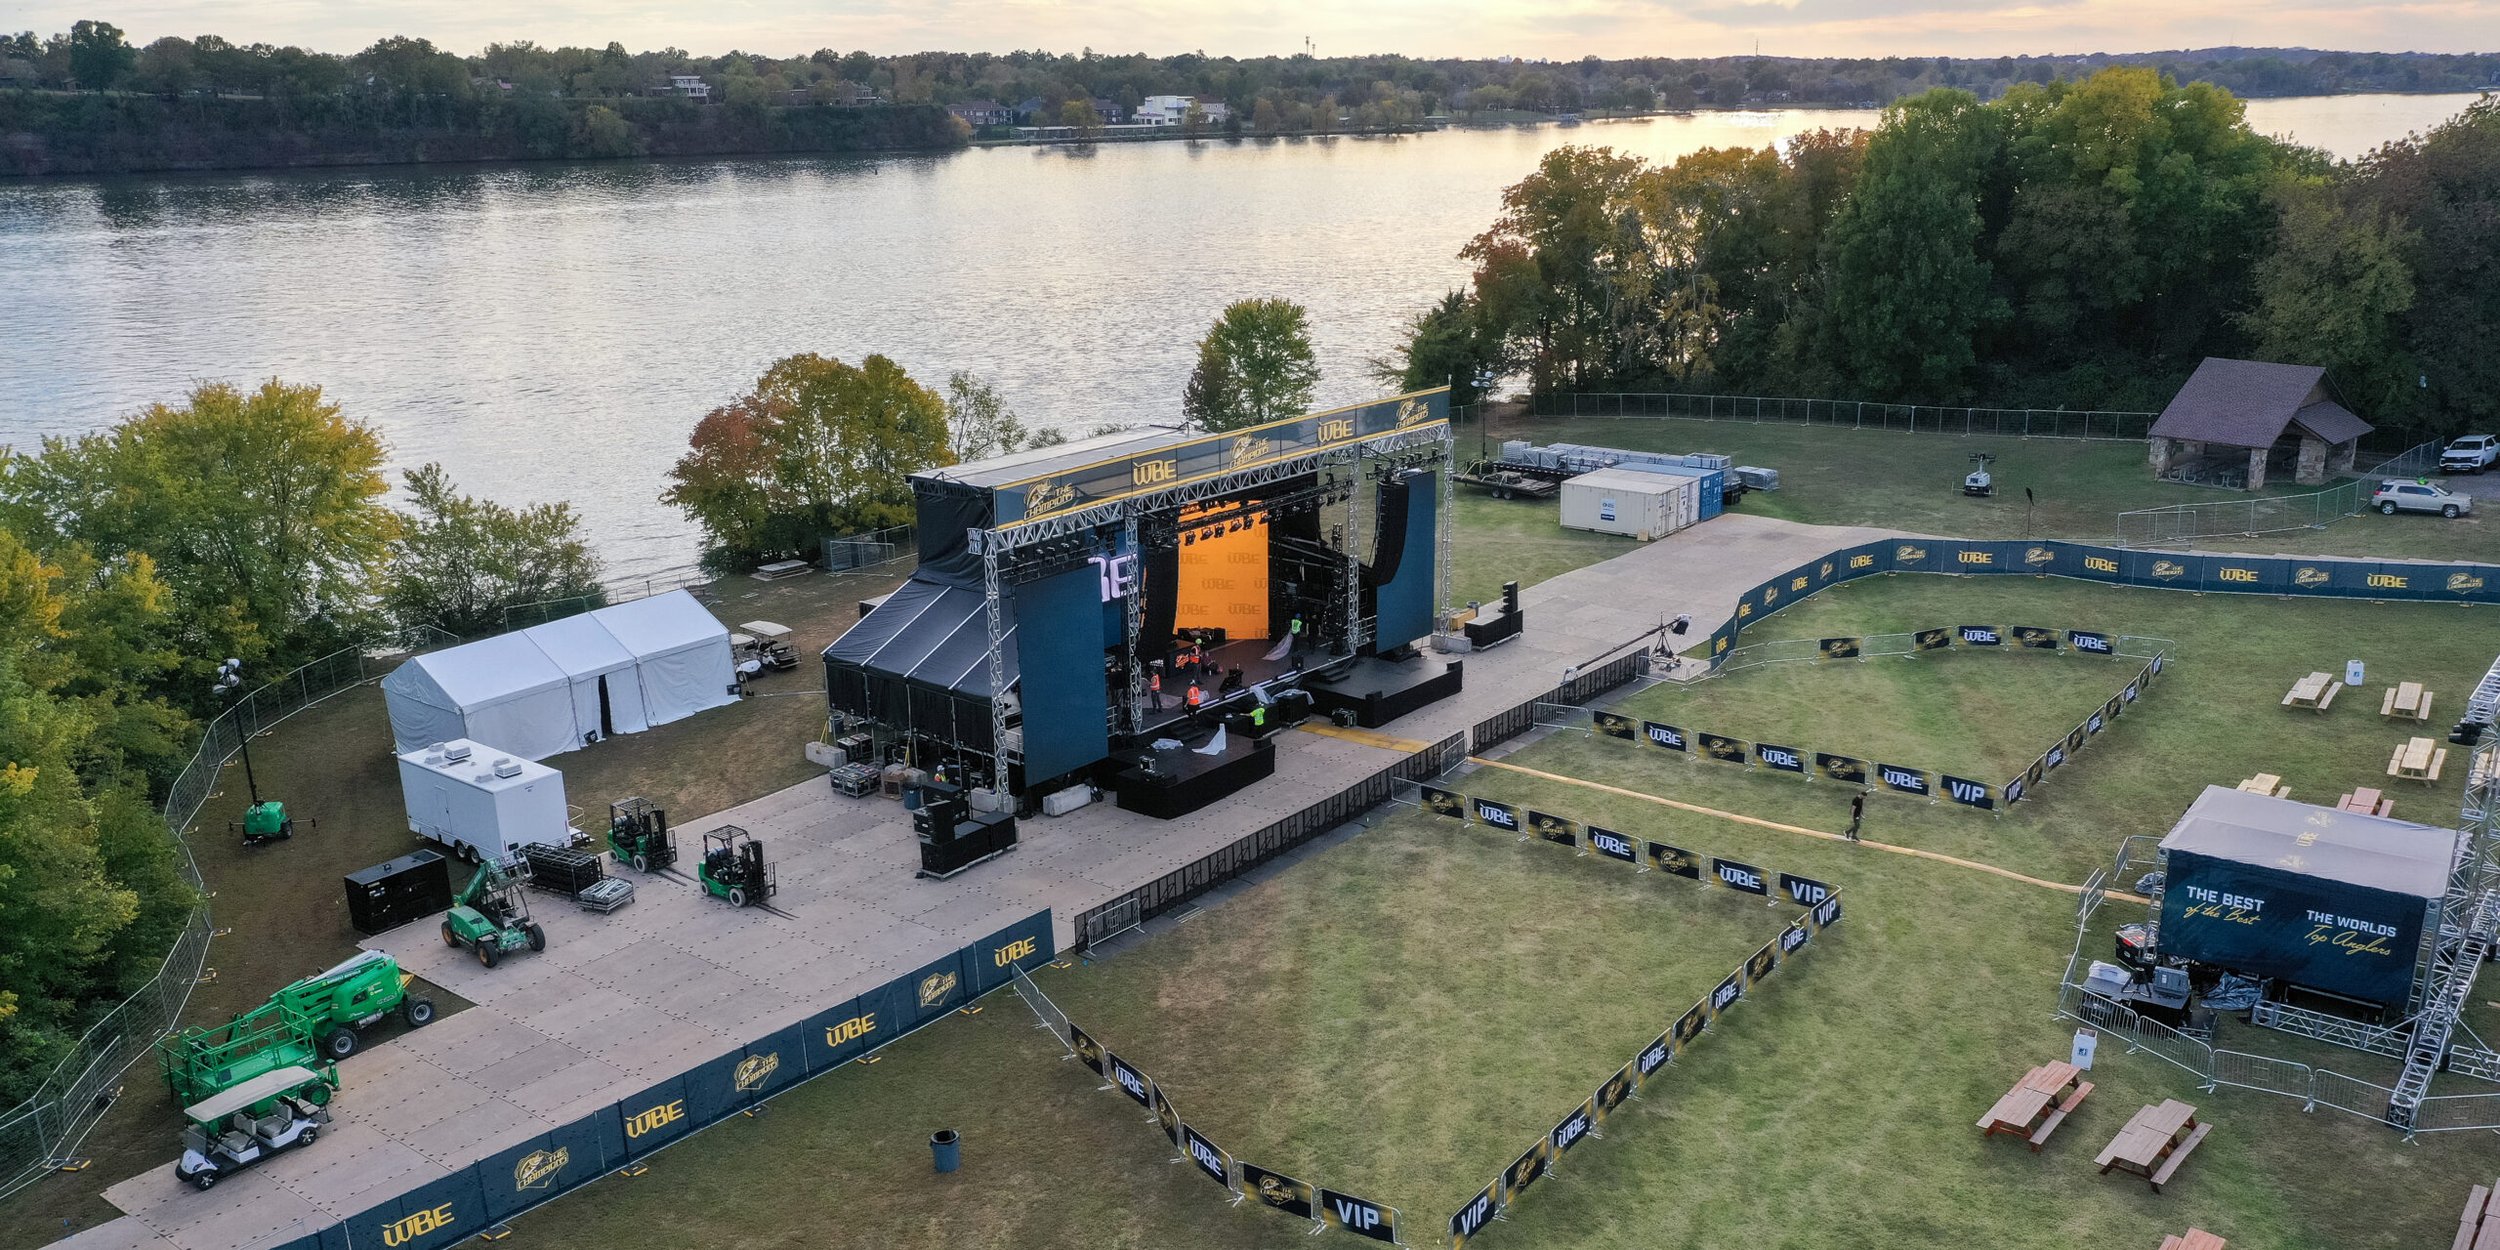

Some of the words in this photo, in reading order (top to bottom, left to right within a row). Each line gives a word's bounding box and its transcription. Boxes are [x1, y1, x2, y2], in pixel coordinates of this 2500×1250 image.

[1318, 419, 1354, 443] WBE
[1132, 459, 1177, 486] WBE
[1850, 554, 1874, 568] WBE
[1958, 550, 1992, 564] WBE
[2085, 555, 2118, 573] WBE
[2220, 567, 2258, 582] WBE
[2367, 573, 2408, 588] WBE
[1964, 628, 1996, 642] WBE
[2073, 634, 2107, 651] WBE
[1649, 725, 1682, 746] WBE
[1762, 748, 1799, 767] WBE
[1883, 768, 1923, 790] WBE
[1952, 781, 1985, 801] VIP
[2009, 781, 2021, 801] VIP
[1479, 803, 1514, 826] WBE
[1594, 831, 1630, 856] WBE
[1719, 863, 1761, 889] WBE
[1791, 880, 1826, 904] VIP
[2187, 885, 2218, 903] THE
[2222, 893, 2264, 912] BEST
[1818, 899, 1836, 925] VIP
[2183, 903, 2200, 919] of
[2199, 902, 2220, 918] the
[2223, 904, 2262, 925] Best
[2306, 909, 2333, 925] THE
[2337, 916, 2397, 938] WORLDS
[1784, 926, 1805, 951] WBE
[2304, 924, 2331, 946] Top
[2332, 931, 2391, 956] Anglers
[994, 936, 1036, 968] WBE
[1715, 981, 1737, 1009] WBE
[825, 1012, 876, 1047] WBE
[1642, 1043, 1666, 1073] WBE
[1115, 1060, 1145, 1099] WBE
[625, 1099, 685, 1139] WBE
[1558, 1113, 1586, 1148] WBE
[1189, 1132, 1222, 1177] WBE
[381, 1201, 455, 1247] WBE
[1335, 1198, 1379, 1230] VIP
[1461, 1195, 1488, 1235] VIP
